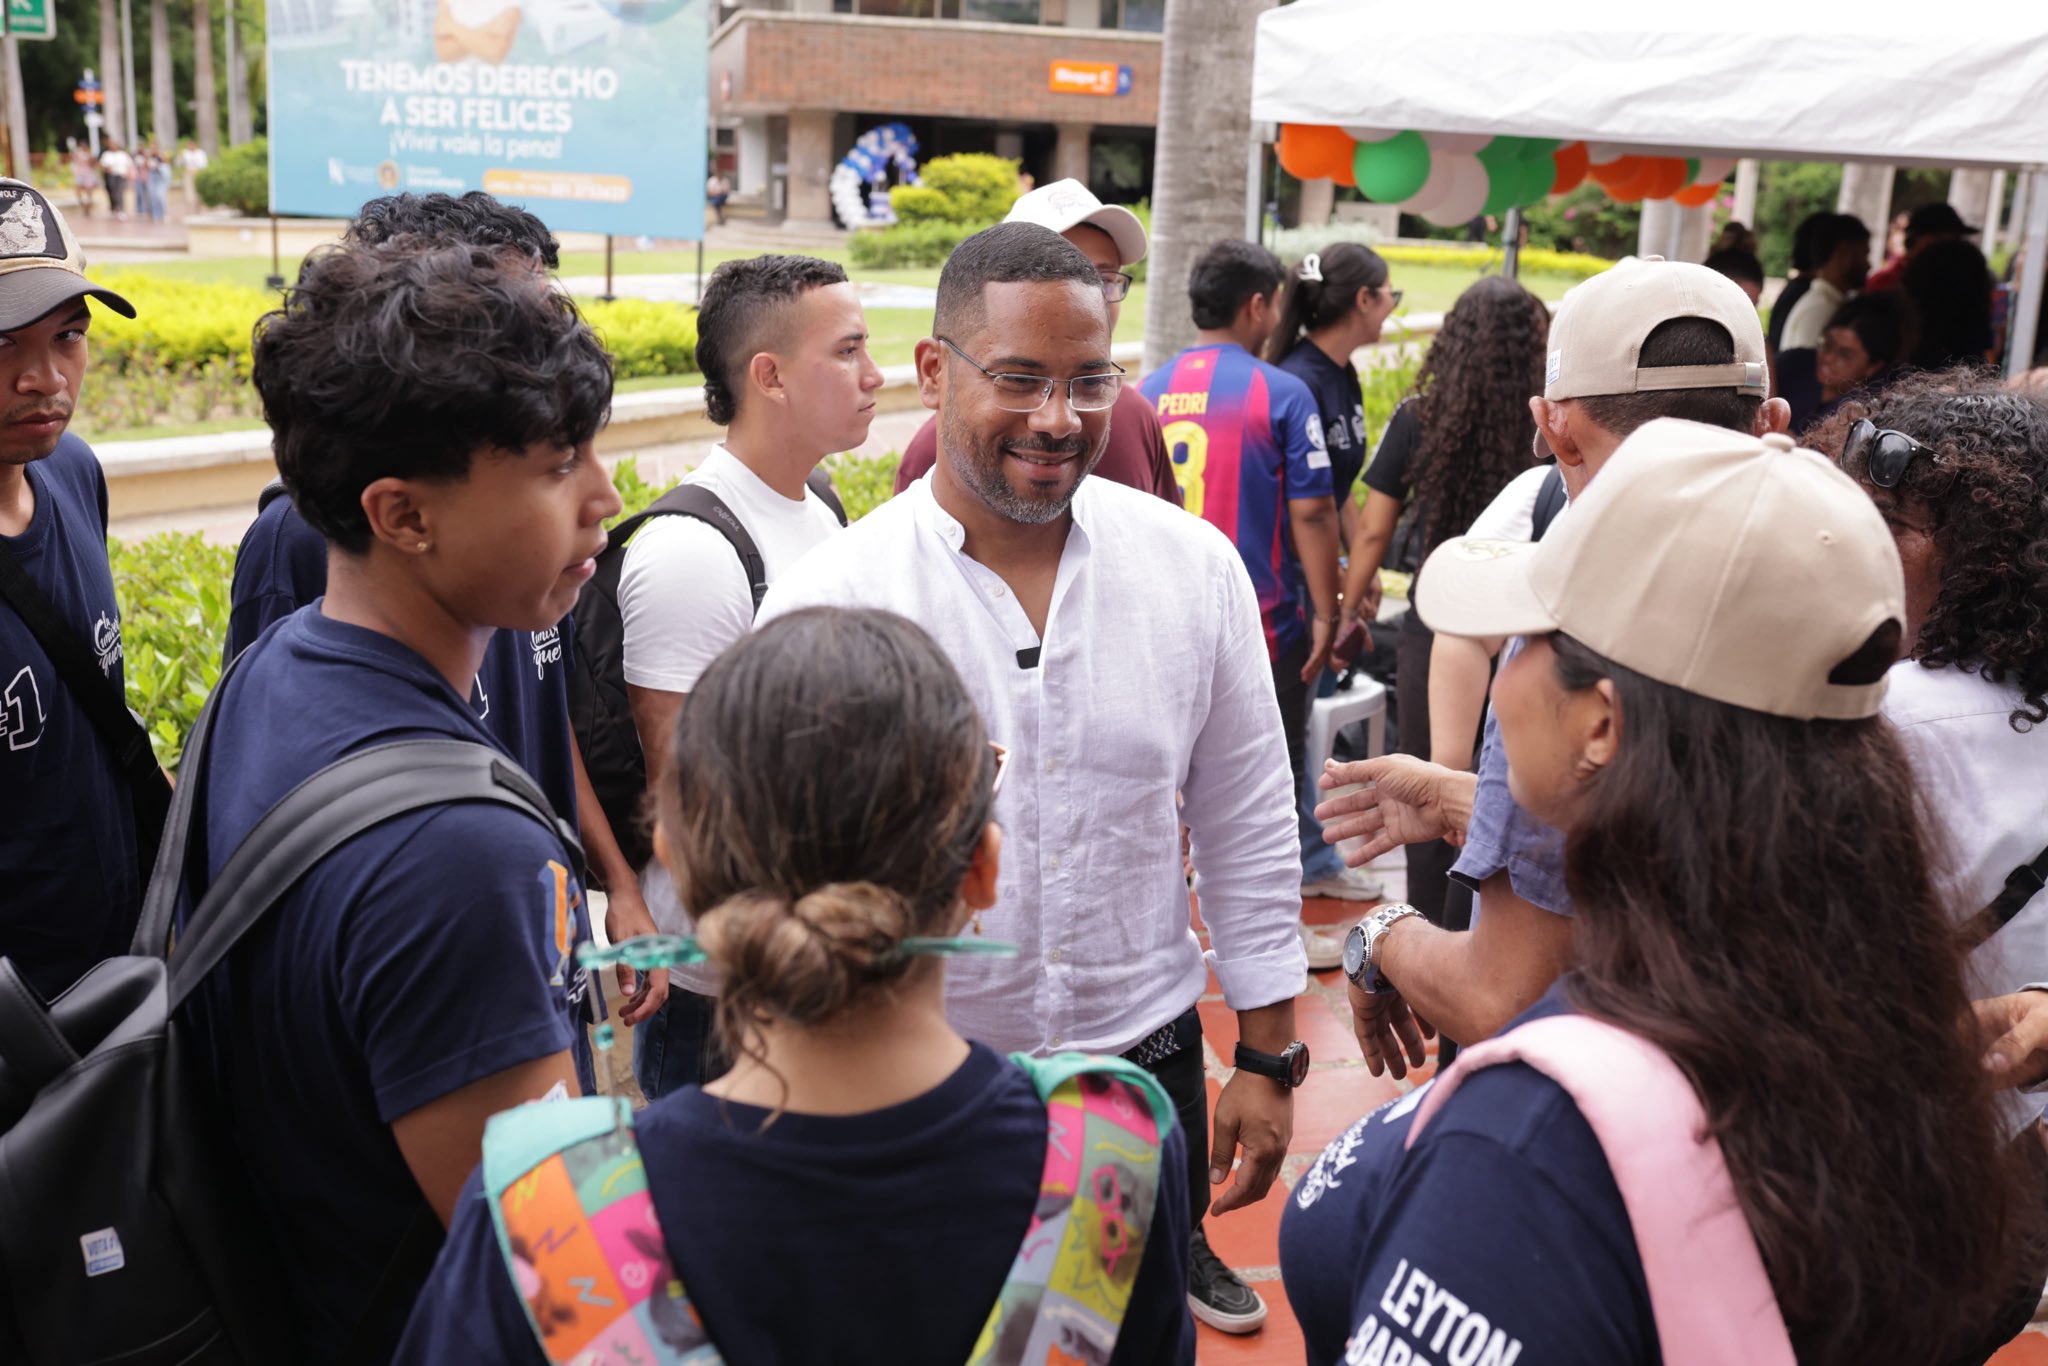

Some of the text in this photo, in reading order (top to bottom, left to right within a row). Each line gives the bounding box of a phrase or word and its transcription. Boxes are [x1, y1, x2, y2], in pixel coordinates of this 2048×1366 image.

[340, 59, 619, 99] TENEMOS DERECHO
[380, 96, 573, 133] A SER FELICES
[442, 133, 480, 156] vale
[482, 134, 502, 156] la
[1157, 392, 1209, 416] PEDRI
[1162, 420, 1208, 517] 8
[1380, 1258, 1522, 1366] LEYTON
